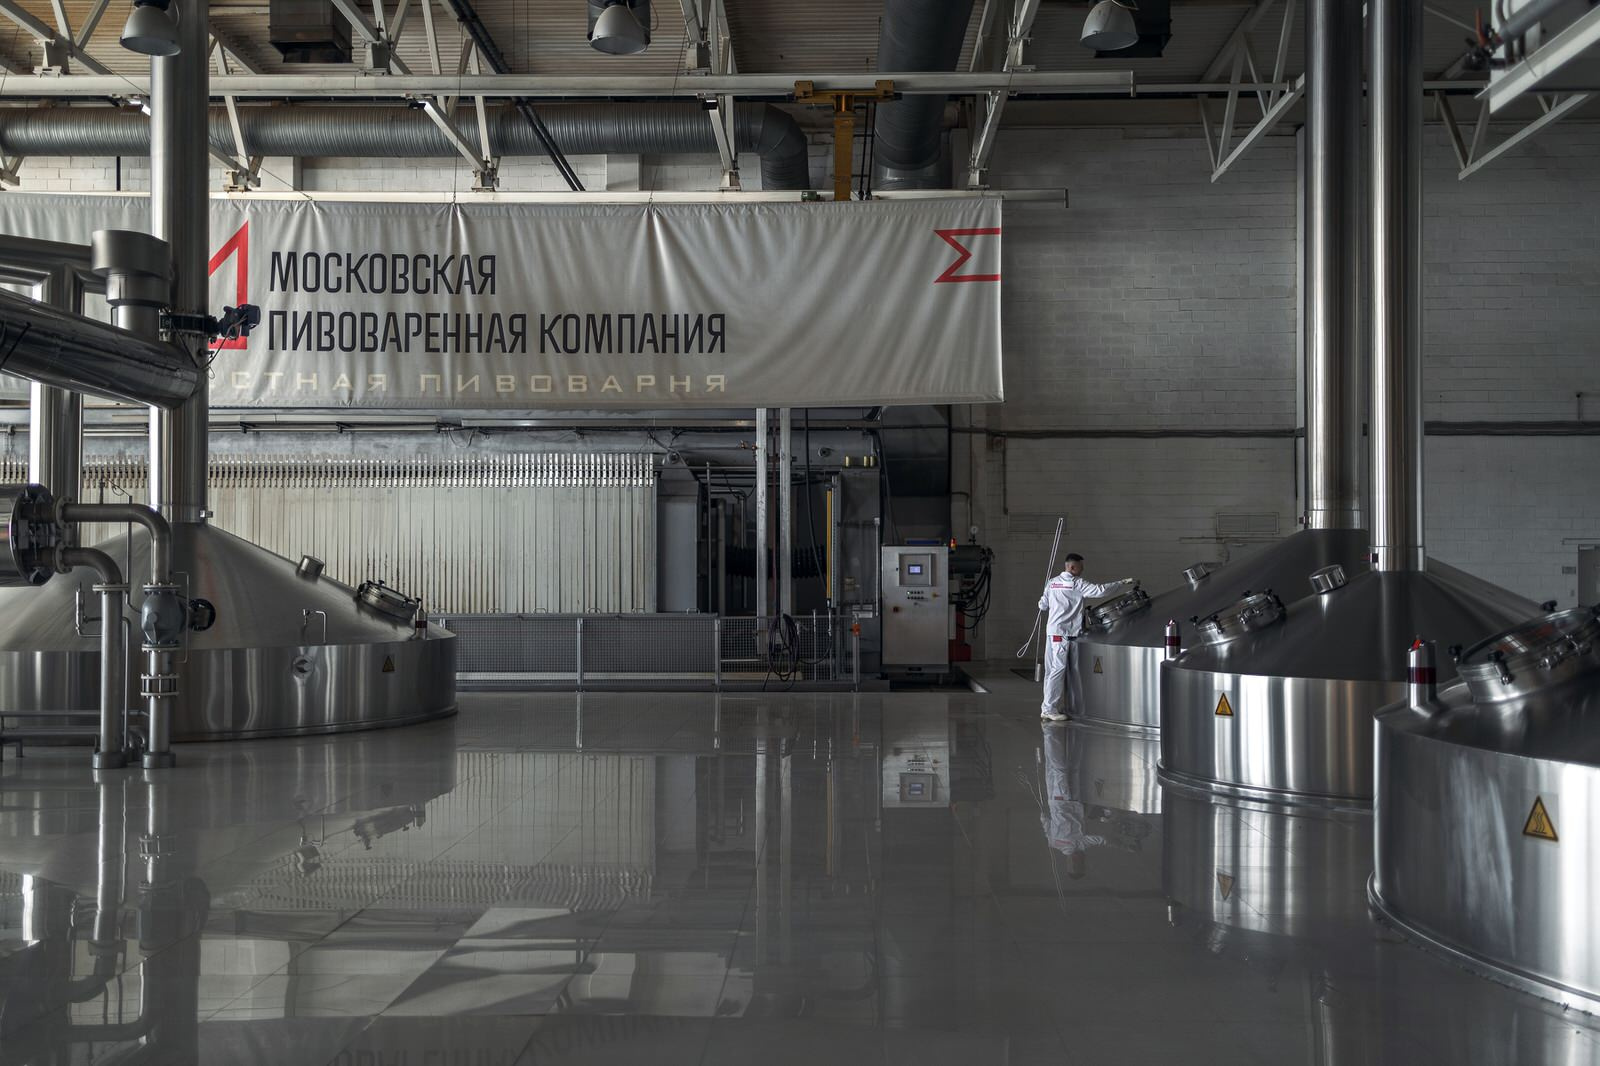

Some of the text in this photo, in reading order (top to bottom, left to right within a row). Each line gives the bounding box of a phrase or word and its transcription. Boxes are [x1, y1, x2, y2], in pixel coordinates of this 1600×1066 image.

[269, 251, 497, 295] МОСКОВСКАЯ
[268, 310, 726, 354] ПИВОВАРЕННАЯ КОМПАНИЯ
[210, 371, 726, 393] СТНАЯ ПИВОВАРНЯ
